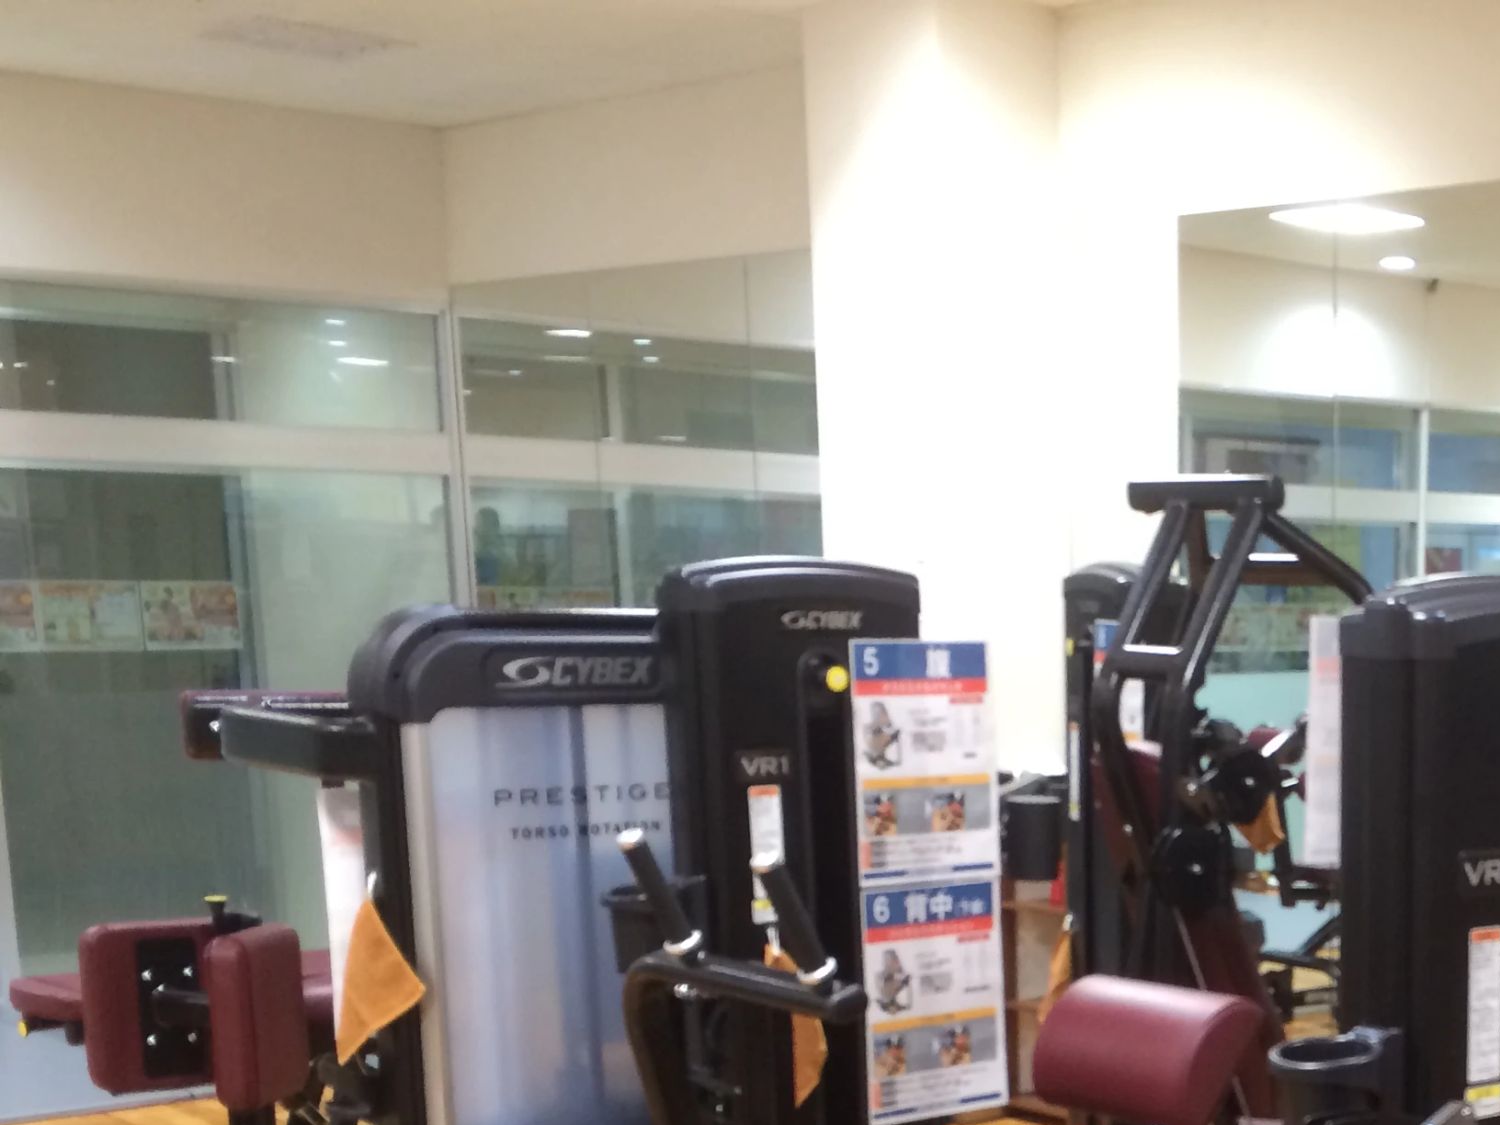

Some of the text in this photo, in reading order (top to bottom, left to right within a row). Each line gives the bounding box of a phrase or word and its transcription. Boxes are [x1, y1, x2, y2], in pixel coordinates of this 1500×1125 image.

[551, 656, 652, 686] CYBEX
[863, 646, 880, 676] 5
[741, 756, 790, 777] VR1
[494, 781, 669, 807] PRESTIGE
[511, 825, 569, 840] TORSO
[872, 895, 890, 924] 6
